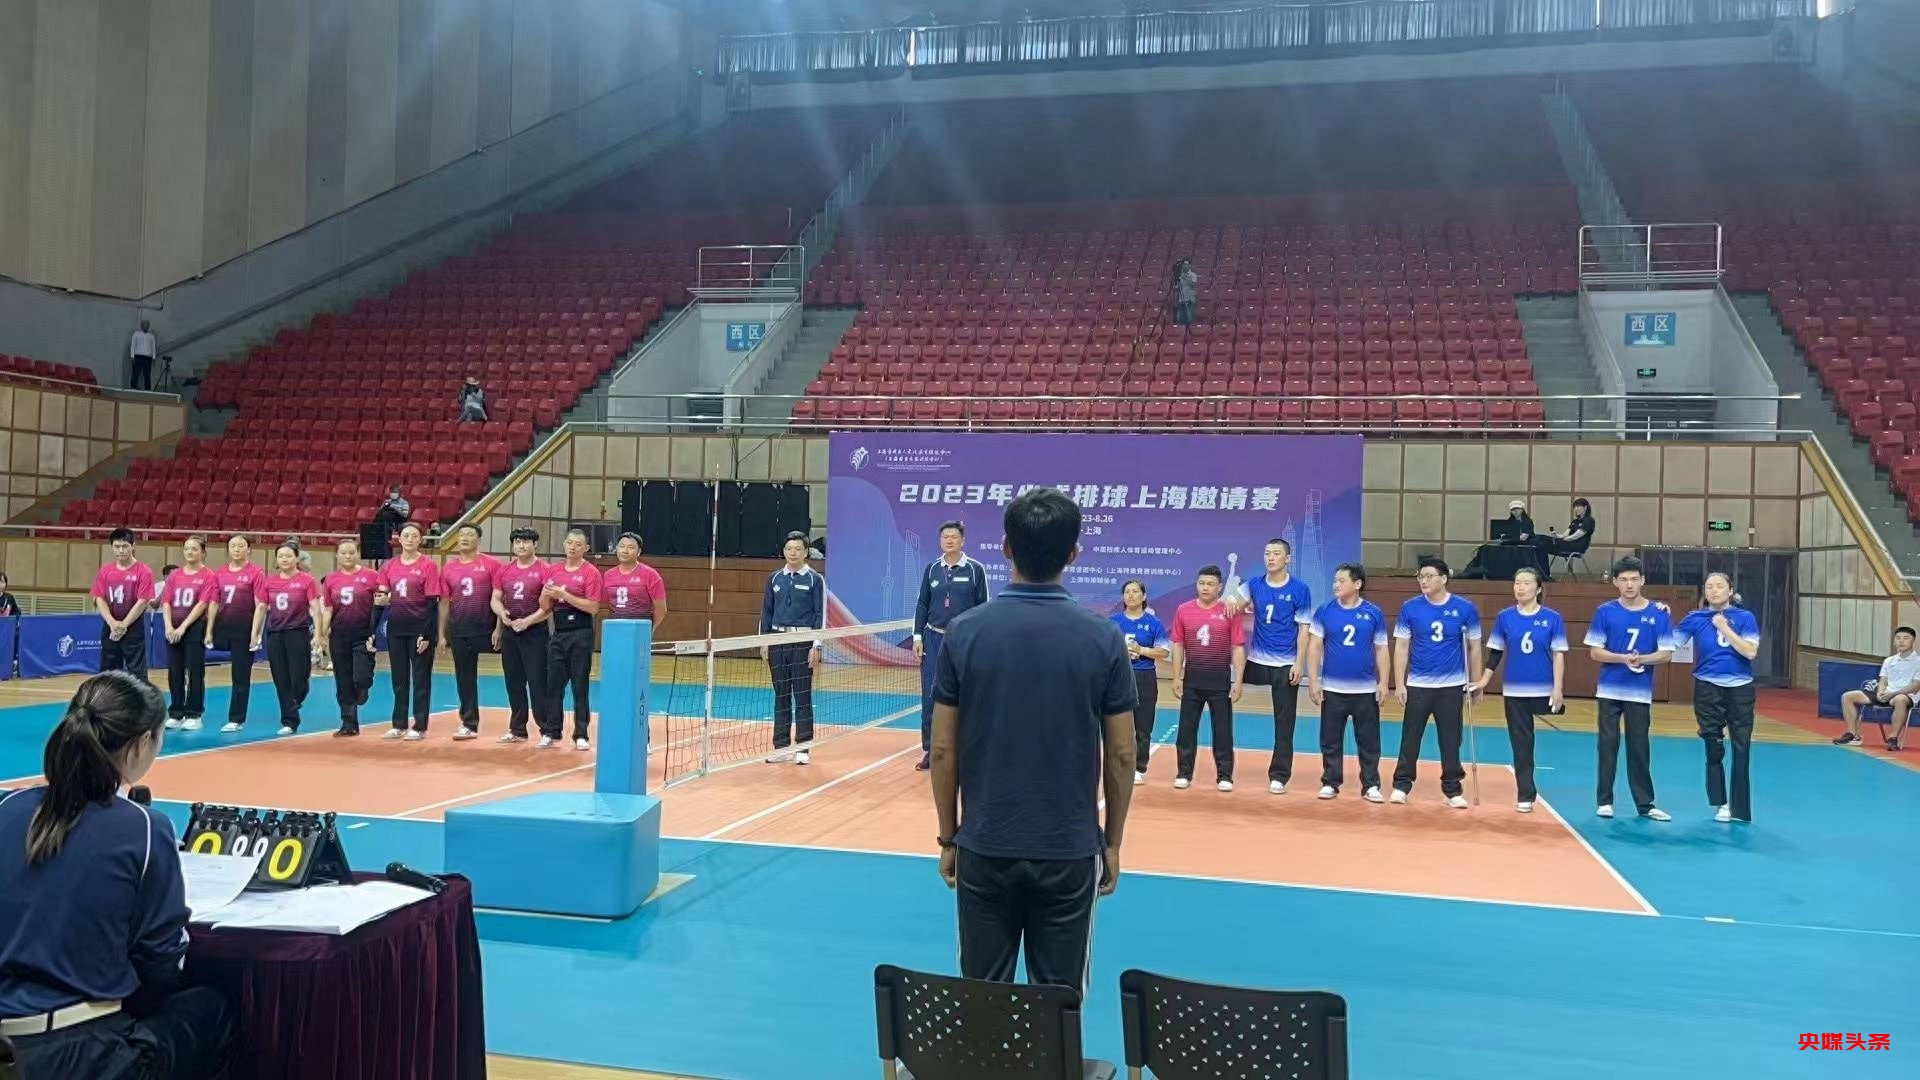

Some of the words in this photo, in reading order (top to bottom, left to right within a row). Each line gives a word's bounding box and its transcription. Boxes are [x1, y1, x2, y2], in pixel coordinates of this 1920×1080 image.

[900, 483, 1280, 511] 2023年排球上海邀请赛
[109, 584, 124, 604] 14
[224, 585, 236, 604] 7
[340, 586, 354, 606] 5
[395, 578, 408, 598] 4
[461, 577, 474, 596] 3
[512, 581, 525, 600] 2
[173, 587, 195, 608] 10
[275, 592, 289, 611] 6
[1265, 604, 1274, 624] 1
[1197, 624, 1210, 646] 4
[1343, 624, 1356, 646] 2
[1430, 621, 1444, 642] 3
[1626, 628, 1640, 650] 7
[1521, 631, 1534, 654] 6
[232, 835, 249, 857] 0
[252, 837, 269, 858] 0
[268, 838, 303, 880] 0
